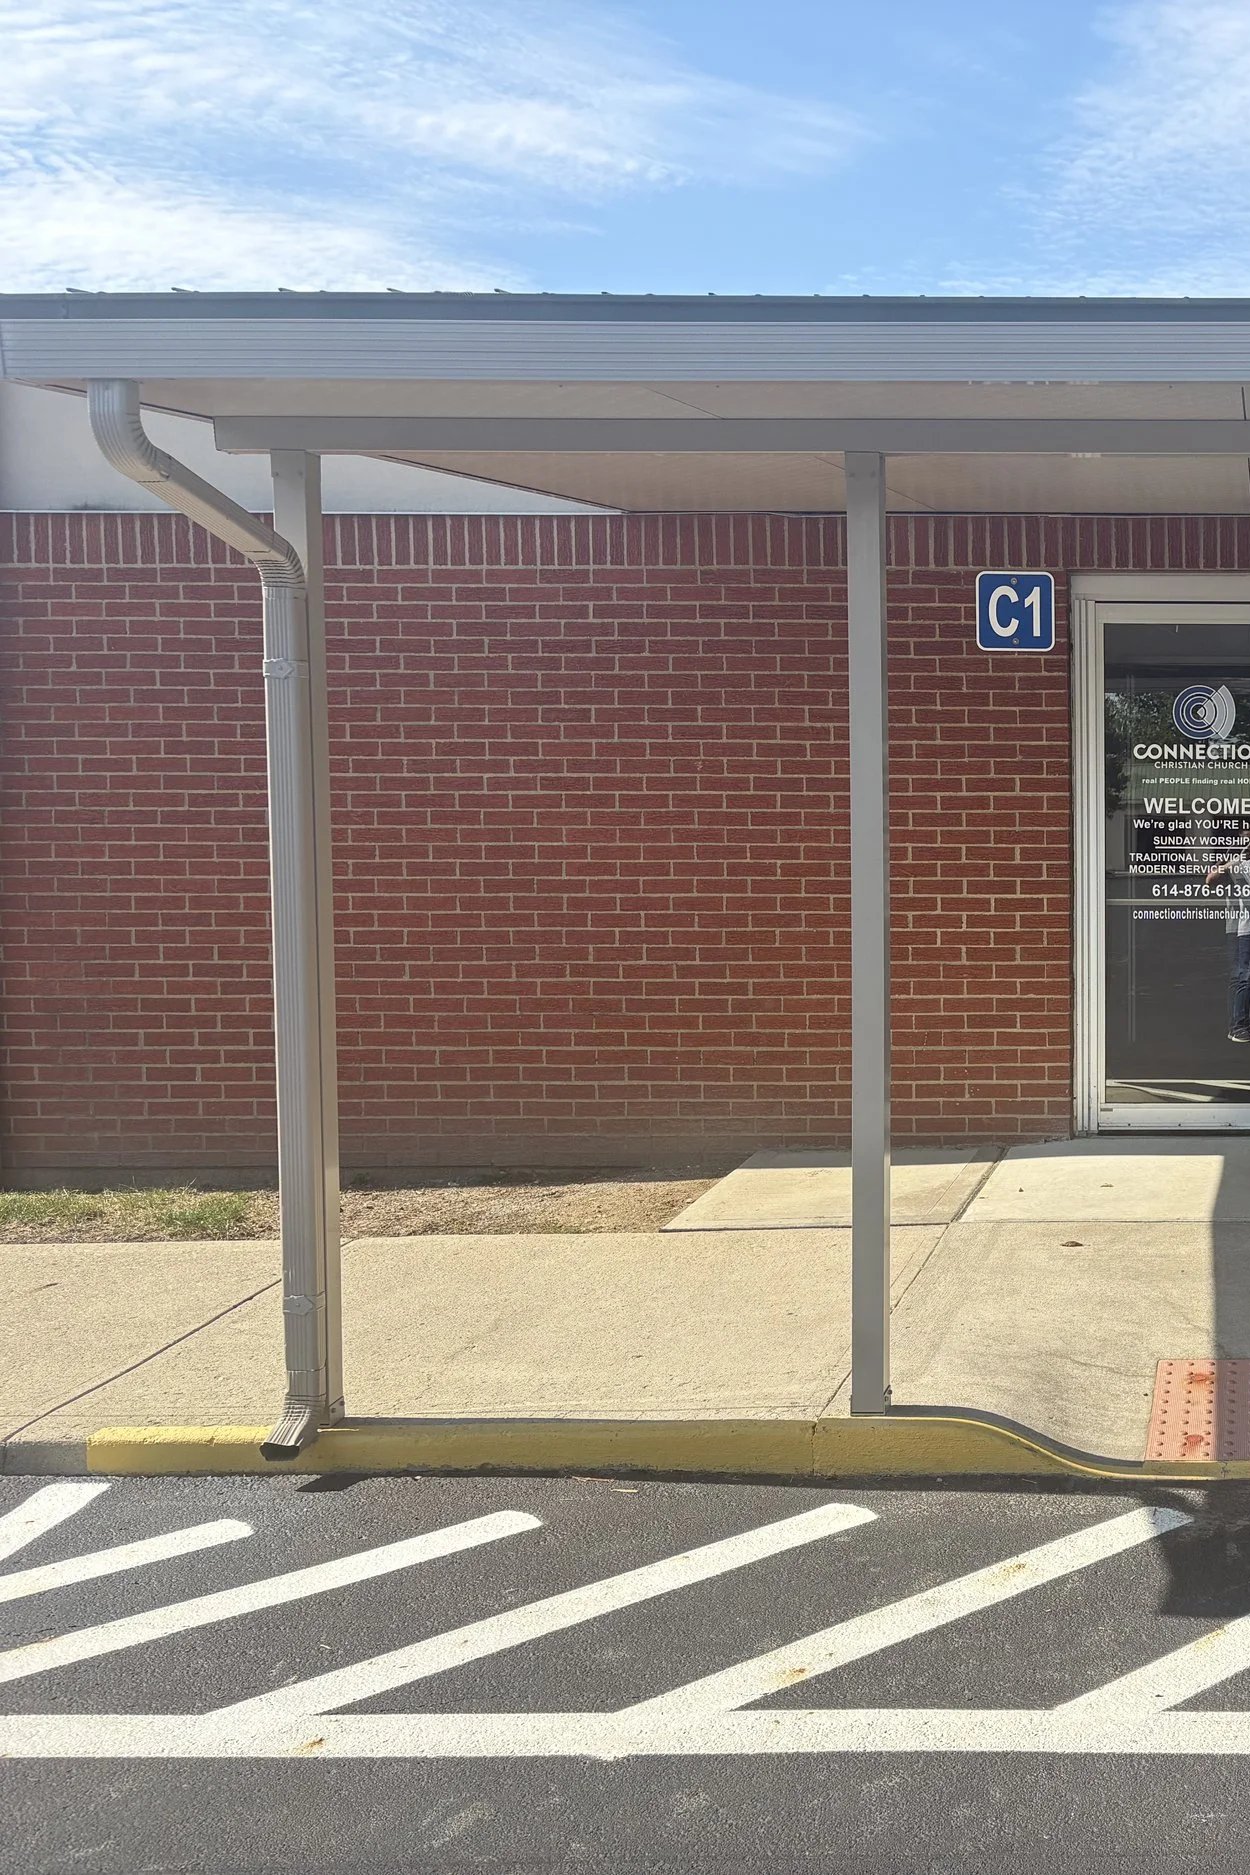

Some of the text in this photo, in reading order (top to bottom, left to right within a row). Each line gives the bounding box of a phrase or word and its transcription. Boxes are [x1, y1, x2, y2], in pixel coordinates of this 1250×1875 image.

[988, 585, 1041, 637] C1
[1154, 761, 1248, 769] CHRISTIAN CHURCH
[1192, 777, 1218, 786] finding
[1133, 819, 1165, 829] We're
[1168, 819, 1192, 832] glad
[1195, 819, 1239, 829] YOU'RE
[1153, 836, 1250, 846] SUNDAY WORSHIP
[1129, 852, 1199, 862] TRADITIONAL
[1202, 852, 1247, 862] SERVICE
[1129, 864, 1176, 874] MODERN
[1178, 864, 1225, 874] SERVICE
[1152, 884, 1250, 897] 614-876-6136
